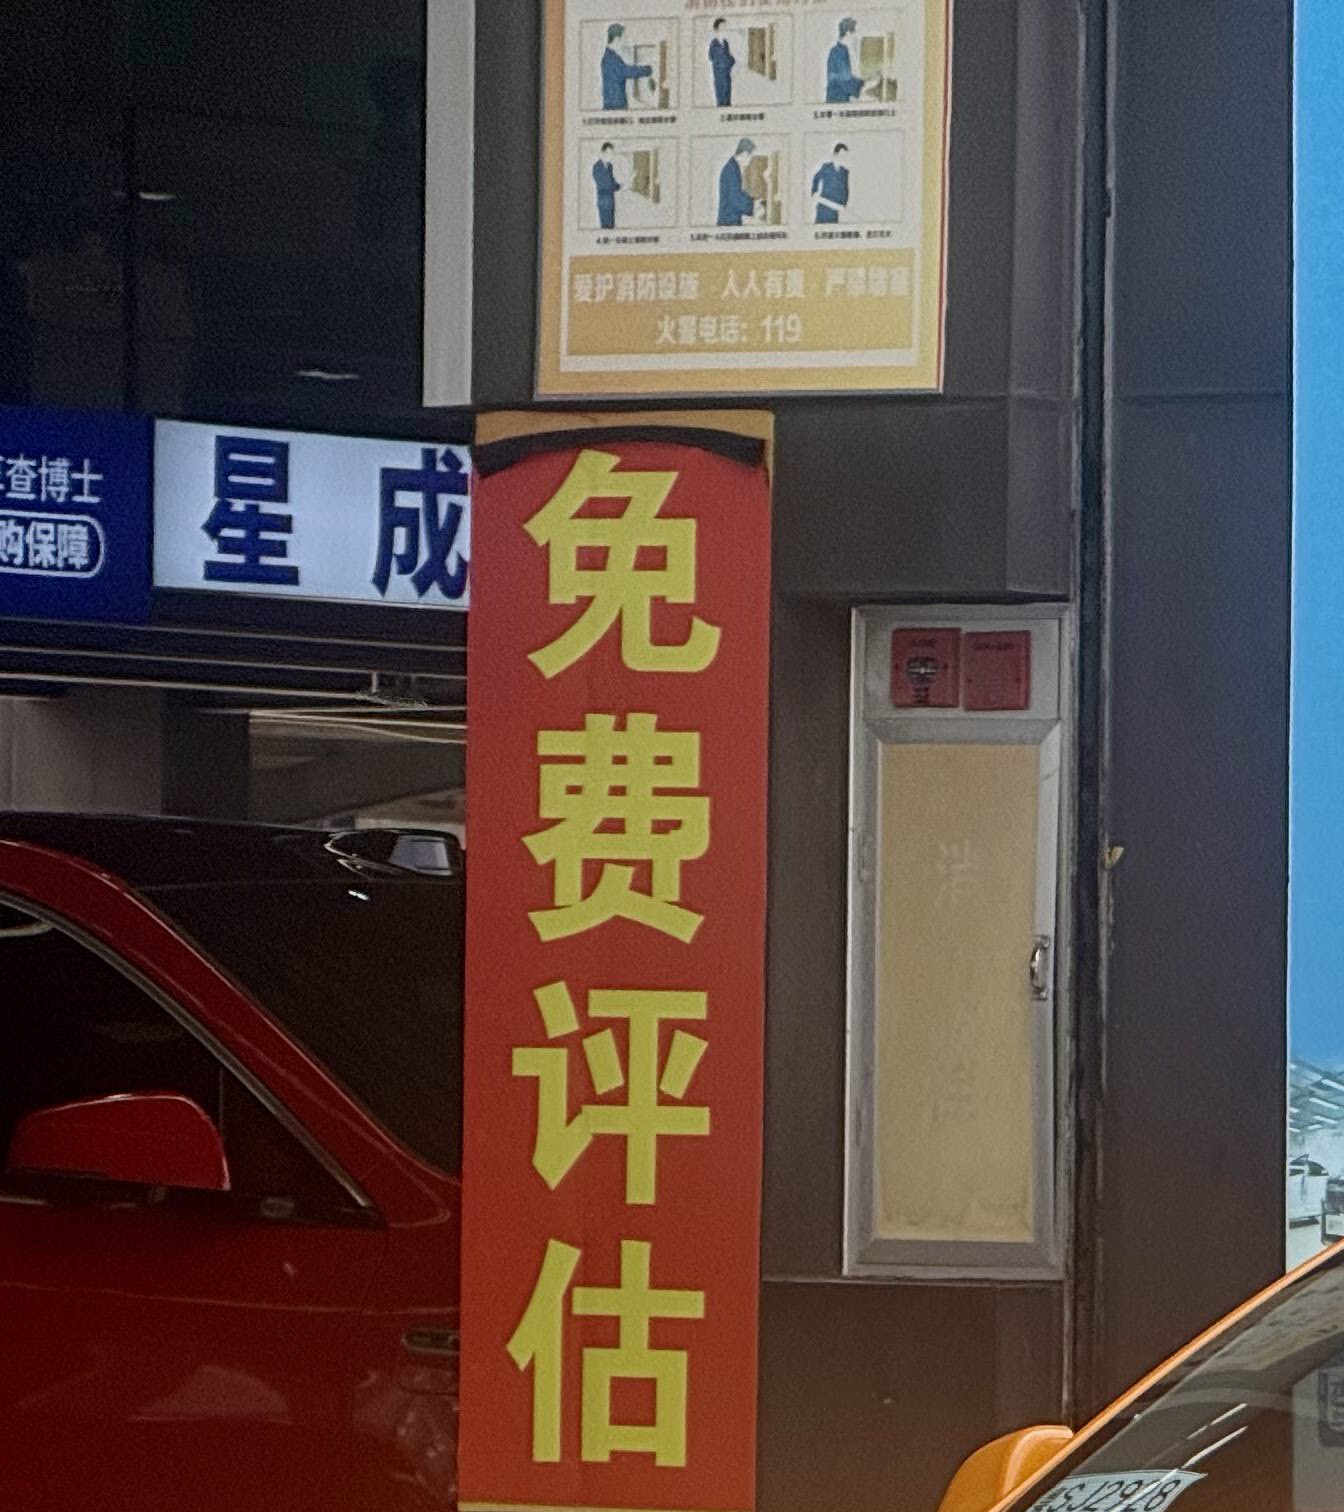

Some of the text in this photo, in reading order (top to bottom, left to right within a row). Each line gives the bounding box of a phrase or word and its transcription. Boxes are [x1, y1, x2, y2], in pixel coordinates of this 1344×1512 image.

[760, 312, 803, 344] 119
[0, 452, 103, 504] 查博士
[507, 447, 721, 1468] 免费评估
